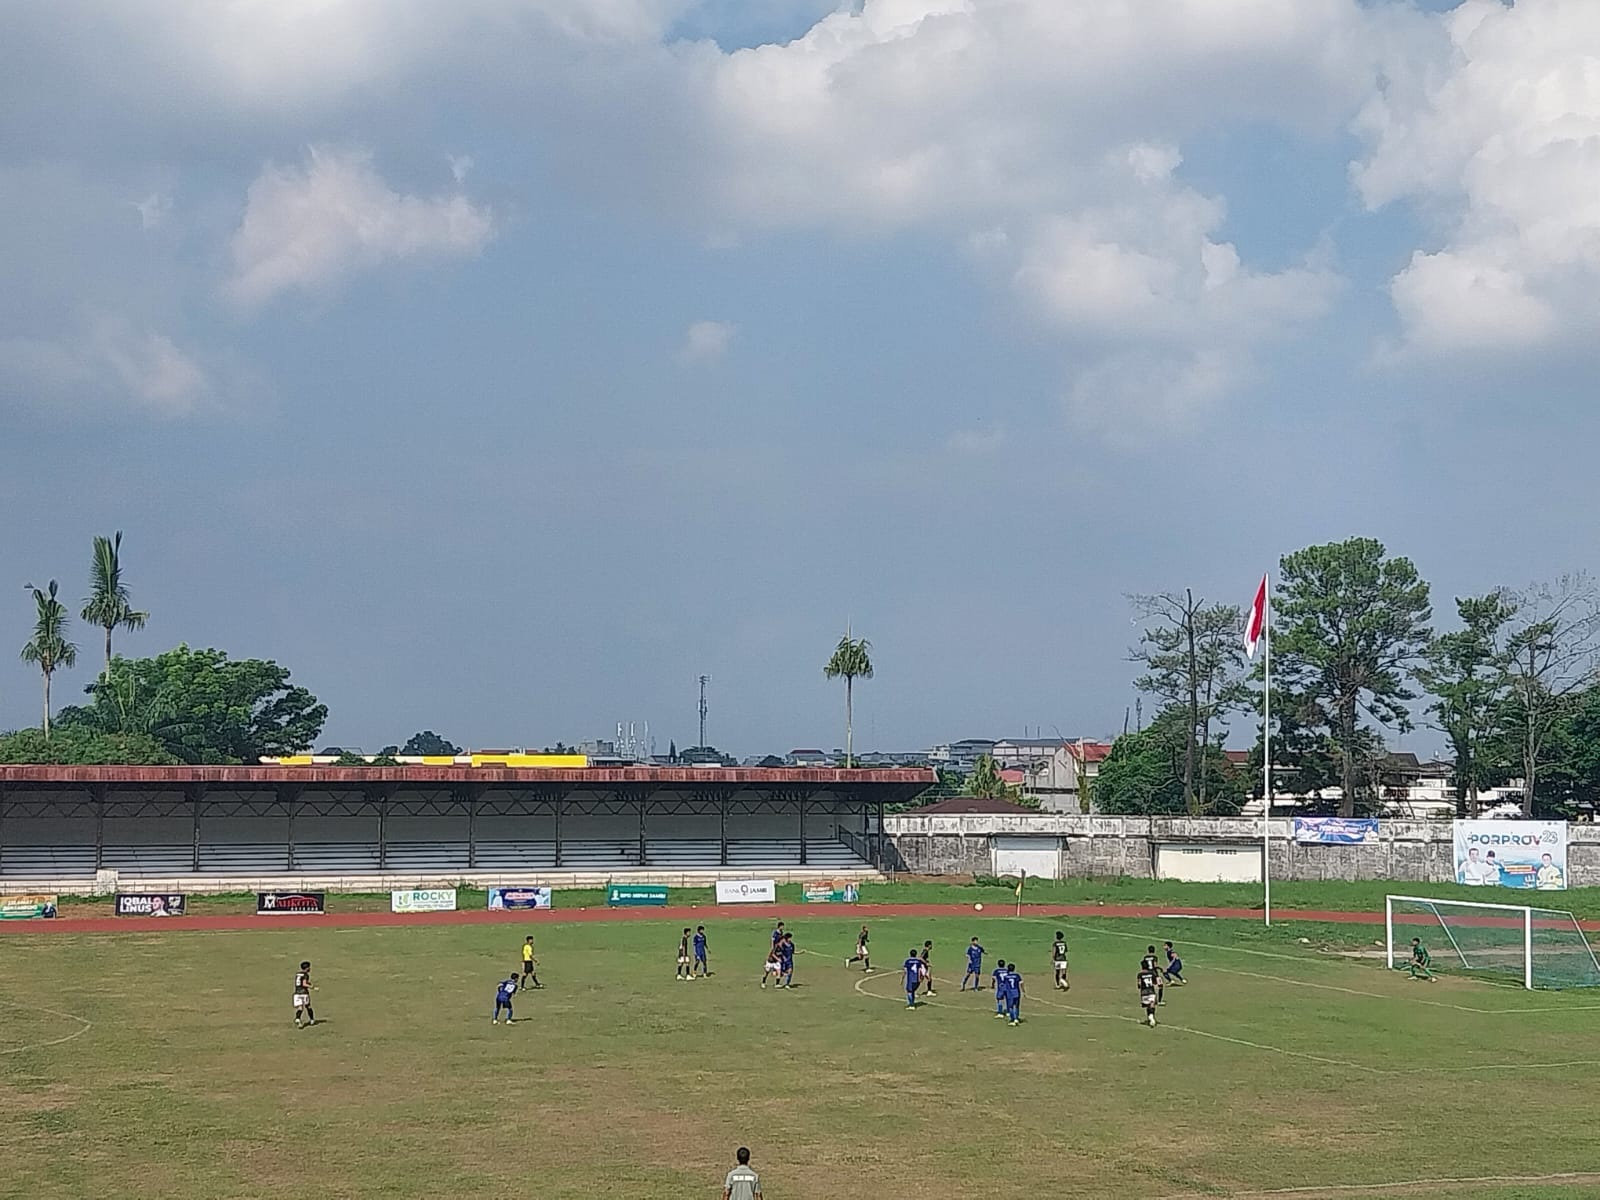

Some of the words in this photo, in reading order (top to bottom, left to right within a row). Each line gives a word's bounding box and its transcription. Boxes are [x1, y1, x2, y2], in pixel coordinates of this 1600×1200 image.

[1468, 834, 1541, 845] PORPROV
[120, 896, 152, 905] IQBAL
[412, 891, 454, 901] ROCKY
[120, 903, 152, 912] LINUS
[911, 963, 917, 973] 4
[1009, 978, 1015, 988] 7
